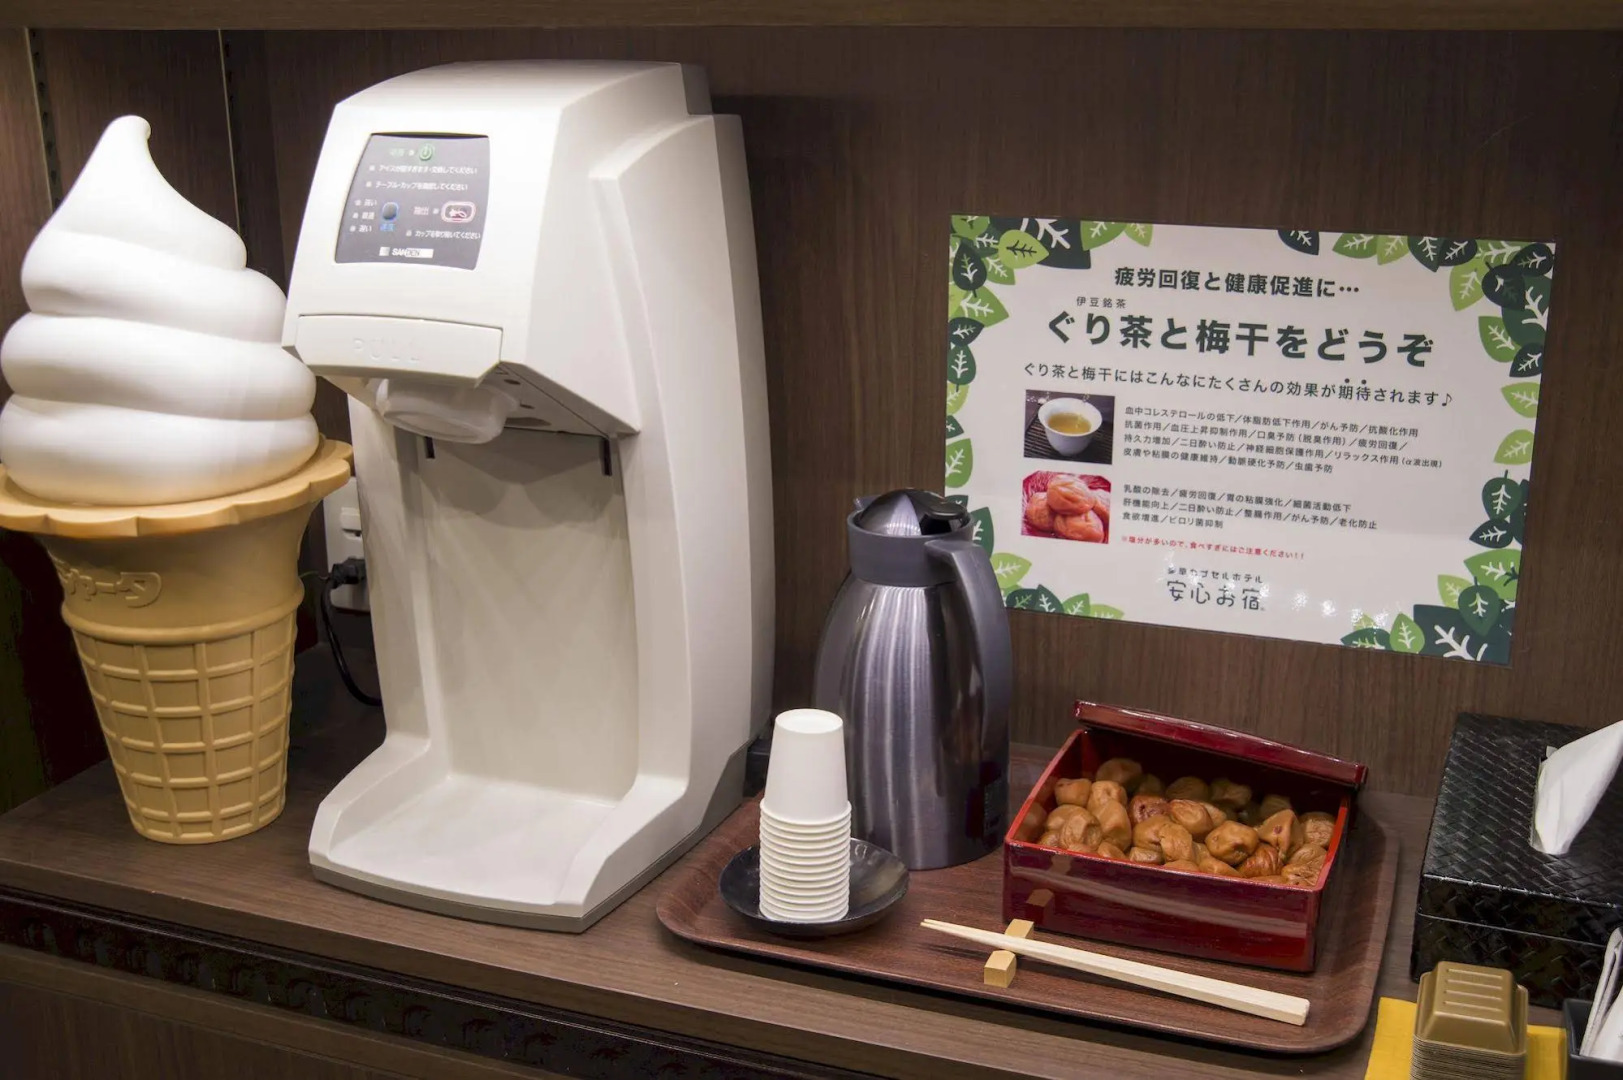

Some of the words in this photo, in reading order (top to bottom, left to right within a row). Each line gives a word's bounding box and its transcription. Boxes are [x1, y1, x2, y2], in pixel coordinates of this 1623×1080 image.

[1076, 296, 1127, 309] 伊豆銘茶
[1049, 310, 1434, 368] ぐり茶と梅干をどうぞ
[1167, 580, 1260, 611] 安心お宿
